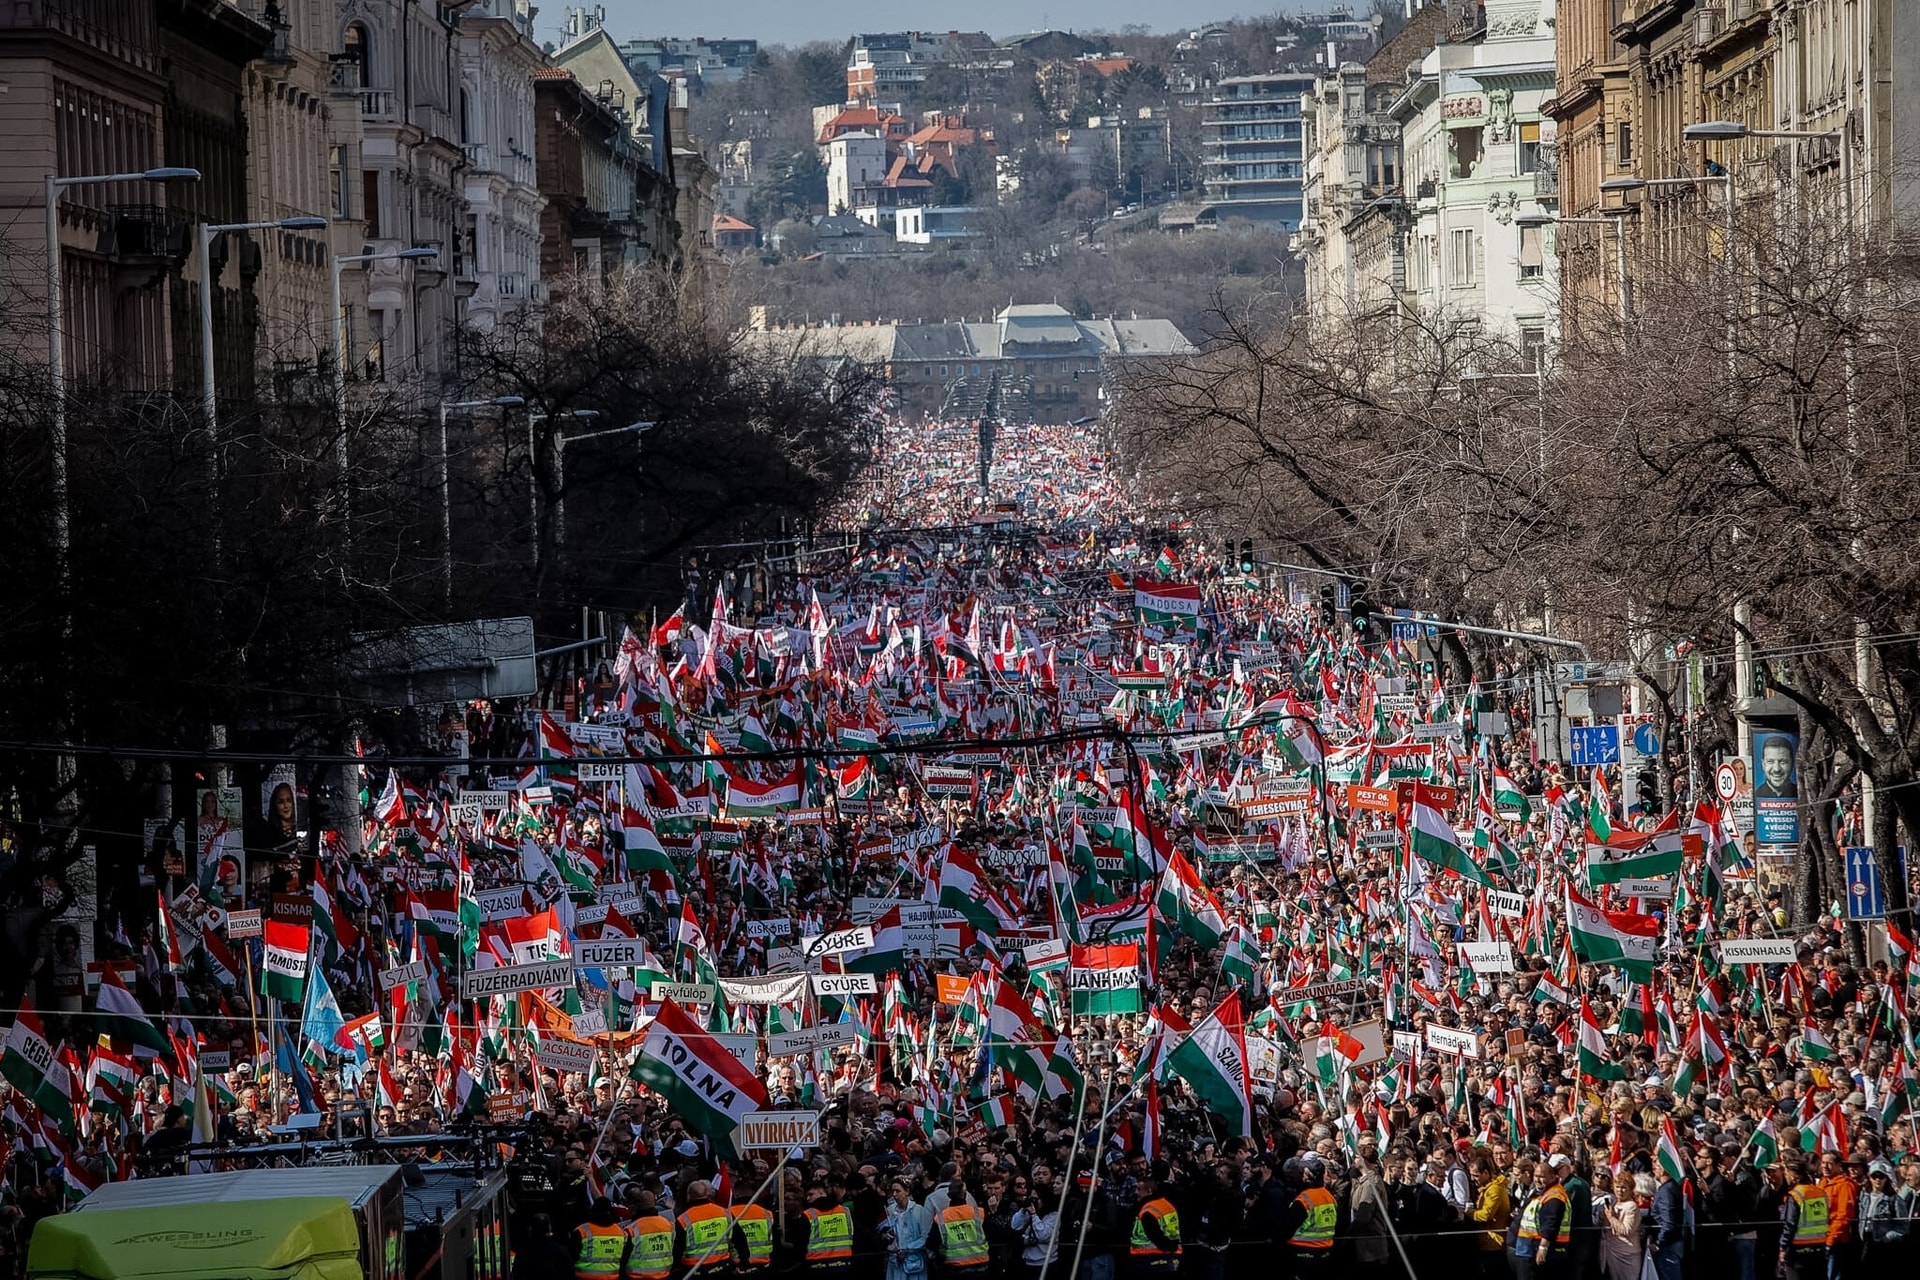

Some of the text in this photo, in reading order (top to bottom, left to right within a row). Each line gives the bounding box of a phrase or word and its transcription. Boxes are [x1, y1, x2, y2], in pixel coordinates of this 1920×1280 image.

[1142, 595, 1192, 611] MADOCSA
[1721, 775, 1732, 790] 30
[1356, 790, 1376, 798] PEST
[452, 804, 479, 820] TASS
[1246, 798, 1308, 817] VERESEGYHÁZ
[1632, 884, 1660, 892] BUGAC
[1488, 894, 1521, 912] GYULA
[582, 944, 635, 963] FÜZÉR
[1725, 943, 1792, 957] KISKUNHALAS
[385, 968, 422, 987] SZIL
[468, 966, 569, 994] FÜZÉRRADVÁNY
[821, 976, 870, 992] GYÜRE
[1284, 979, 1365, 1003] KISKUNMAJSA
[660, 1035, 737, 1110] TOLNA
[744, 1119, 814, 1142] NYÍRKÁTA
